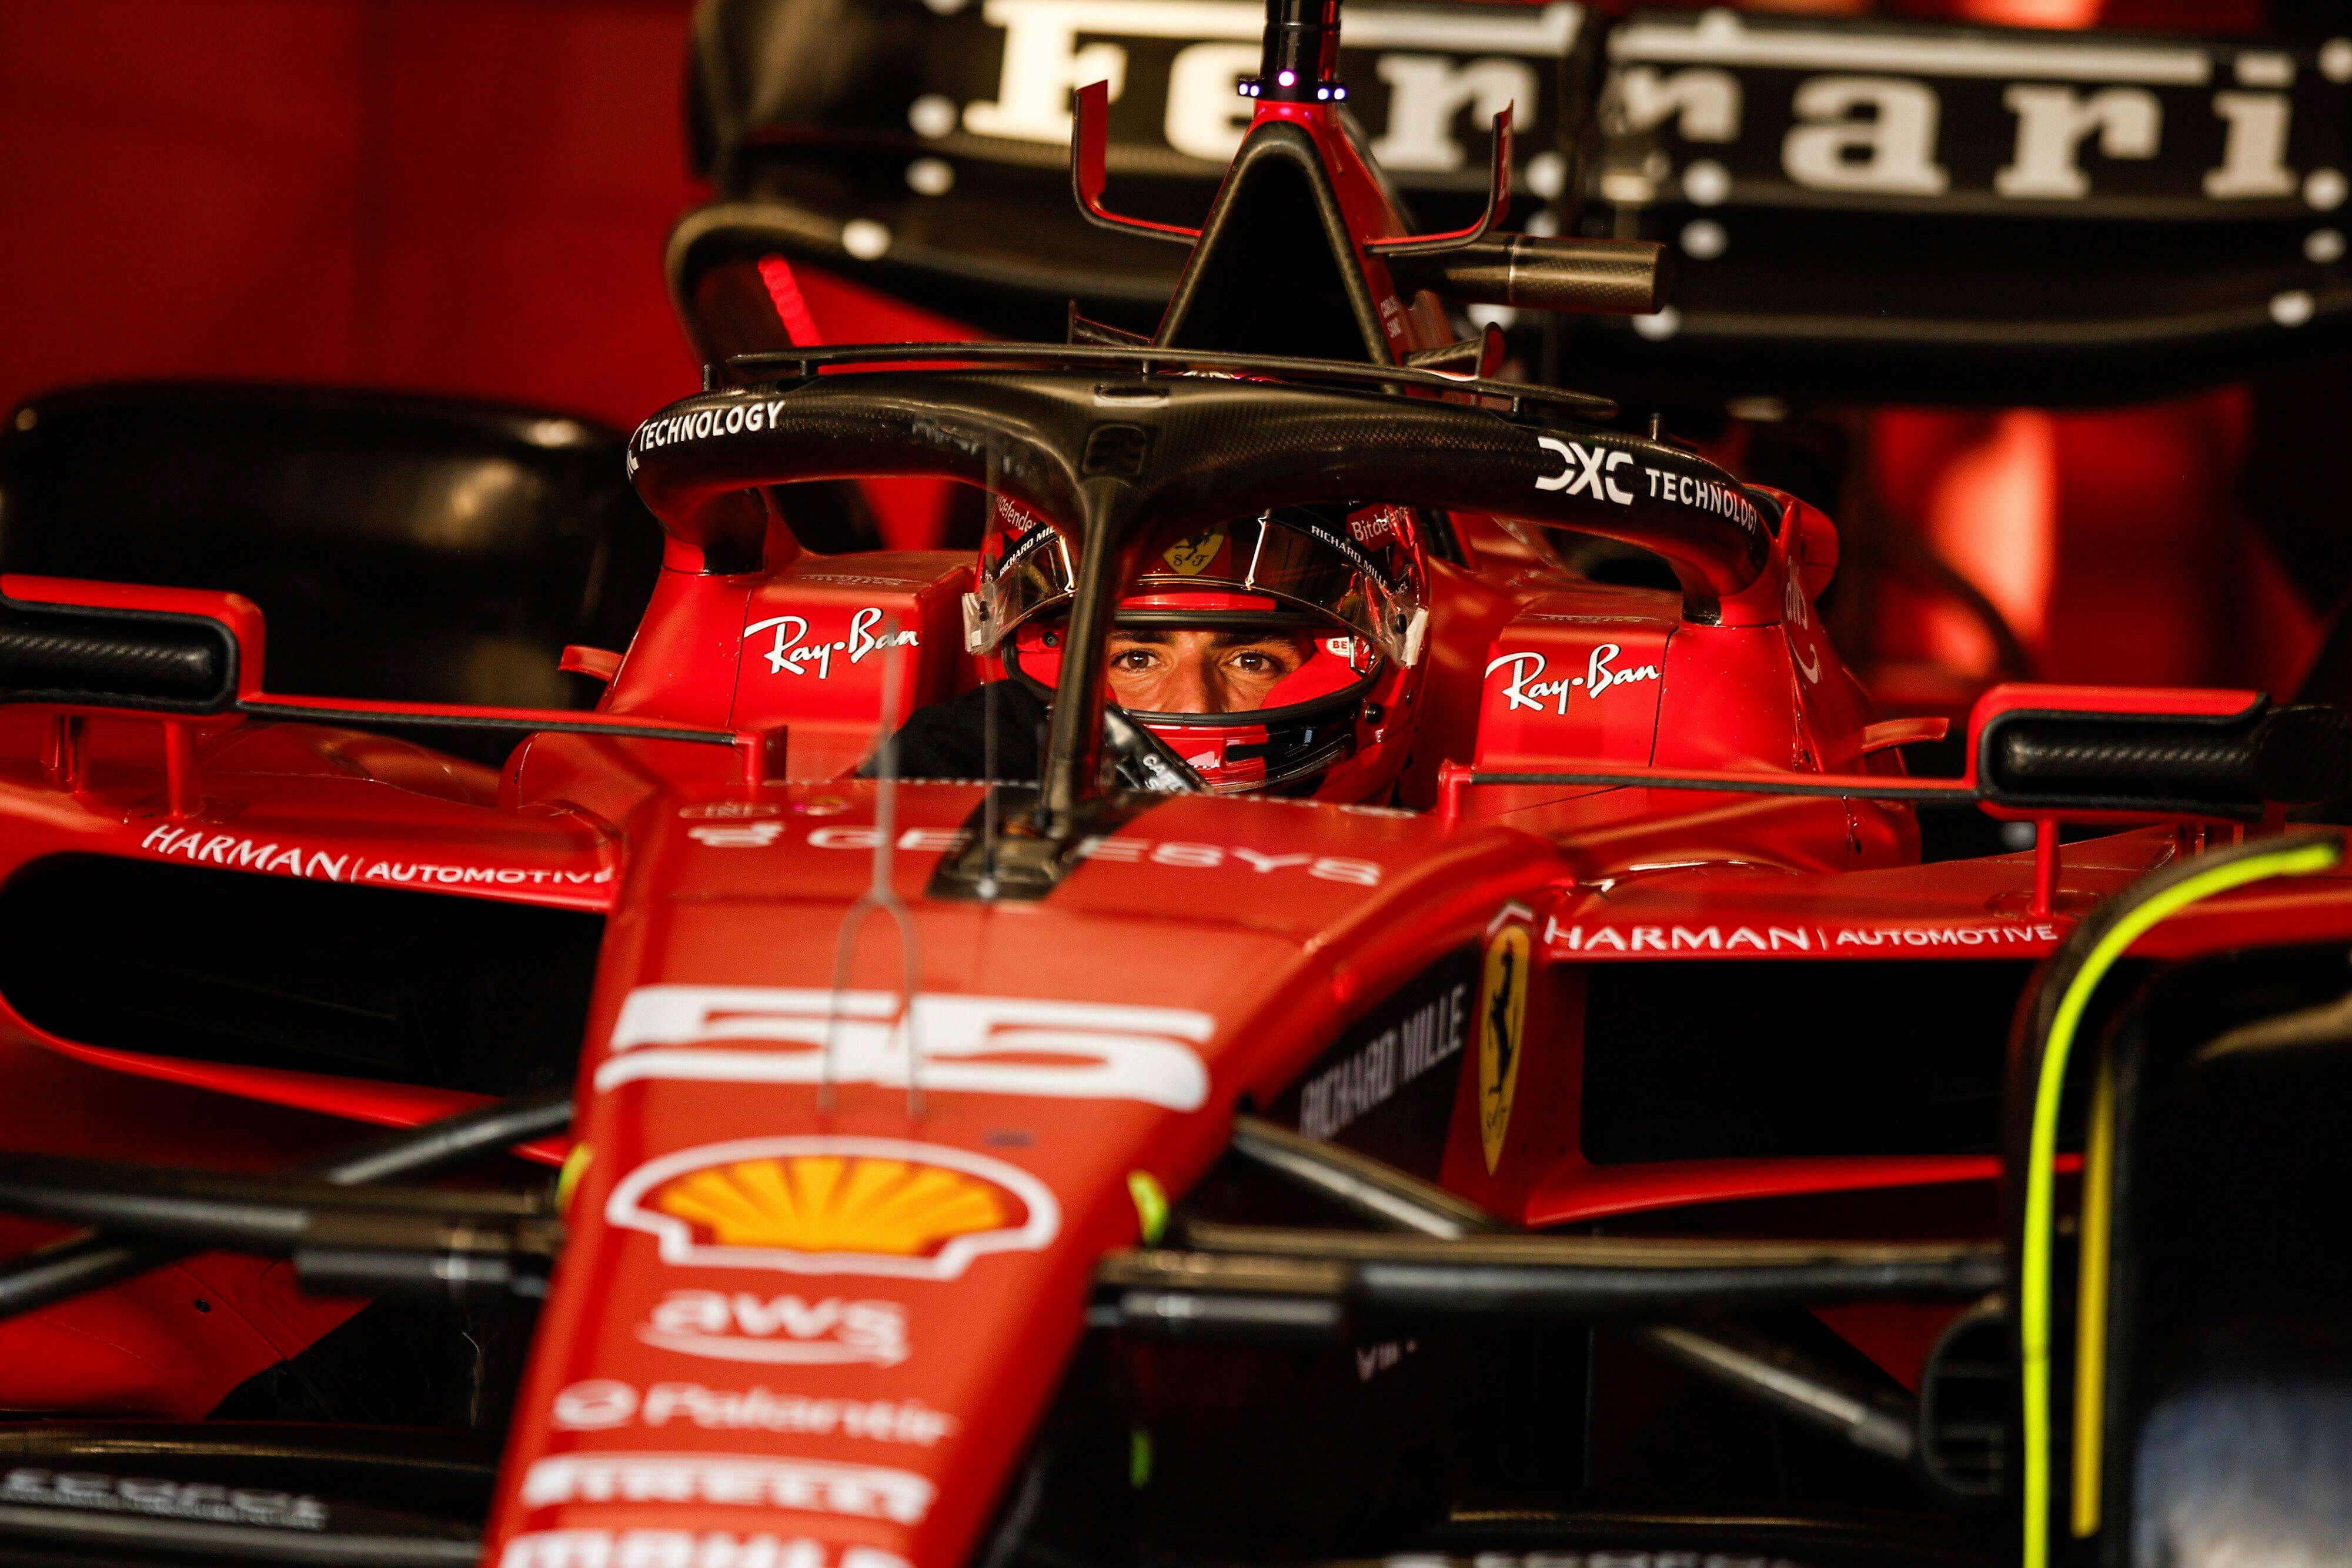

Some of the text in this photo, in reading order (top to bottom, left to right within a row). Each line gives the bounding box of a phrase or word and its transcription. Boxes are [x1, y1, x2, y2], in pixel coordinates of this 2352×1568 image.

[640, 400, 786, 452] TECHNOLOGY
[1535, 437, 1634, 506] DXC
[1036, 526, 1055, 542] MIL
[1311, 525, 1361, 563] RICHARD
[743, 608, 920, 679] Ray-Ban
[1333, 640, 1348, 649] BE
[1485, 644, 1661, 715] Ray-Ban
[141, 824, 348, 881] HARMAN
[807, 824, 1382, 887] GEESYS
[1544, 915, 2059, 951] HARMAN AUTOMOTIVE
[595, 985, 1215, 1111] 55
[650, 1290, 906, 1348] aws
